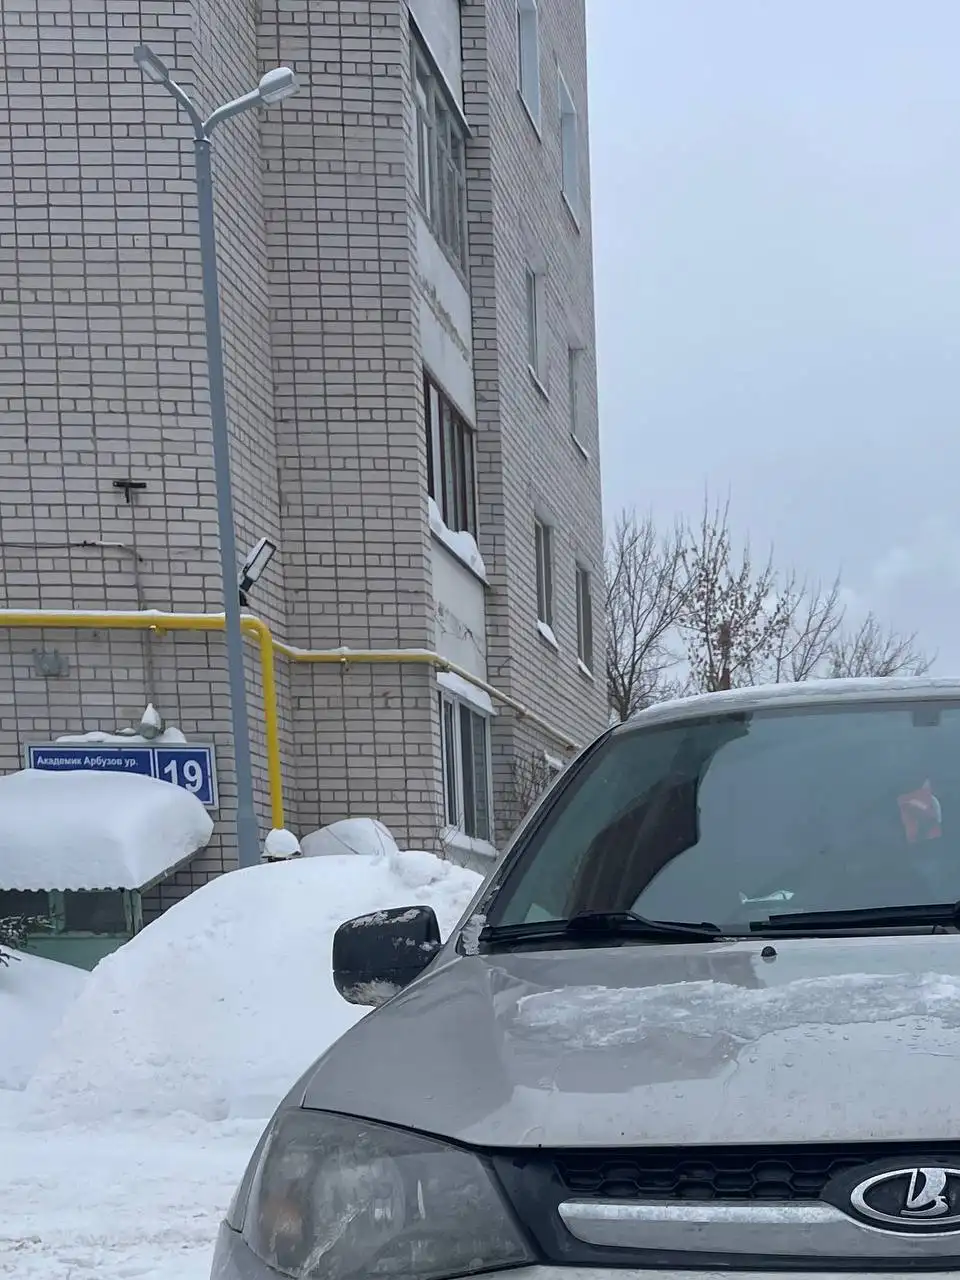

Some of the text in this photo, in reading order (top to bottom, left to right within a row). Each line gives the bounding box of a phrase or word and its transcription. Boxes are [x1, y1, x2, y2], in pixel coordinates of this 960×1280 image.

[37, 755, 81, 766] Академик
[84, 755, 123, 768] Арбузов
[164, 759, 203, 793] 19
